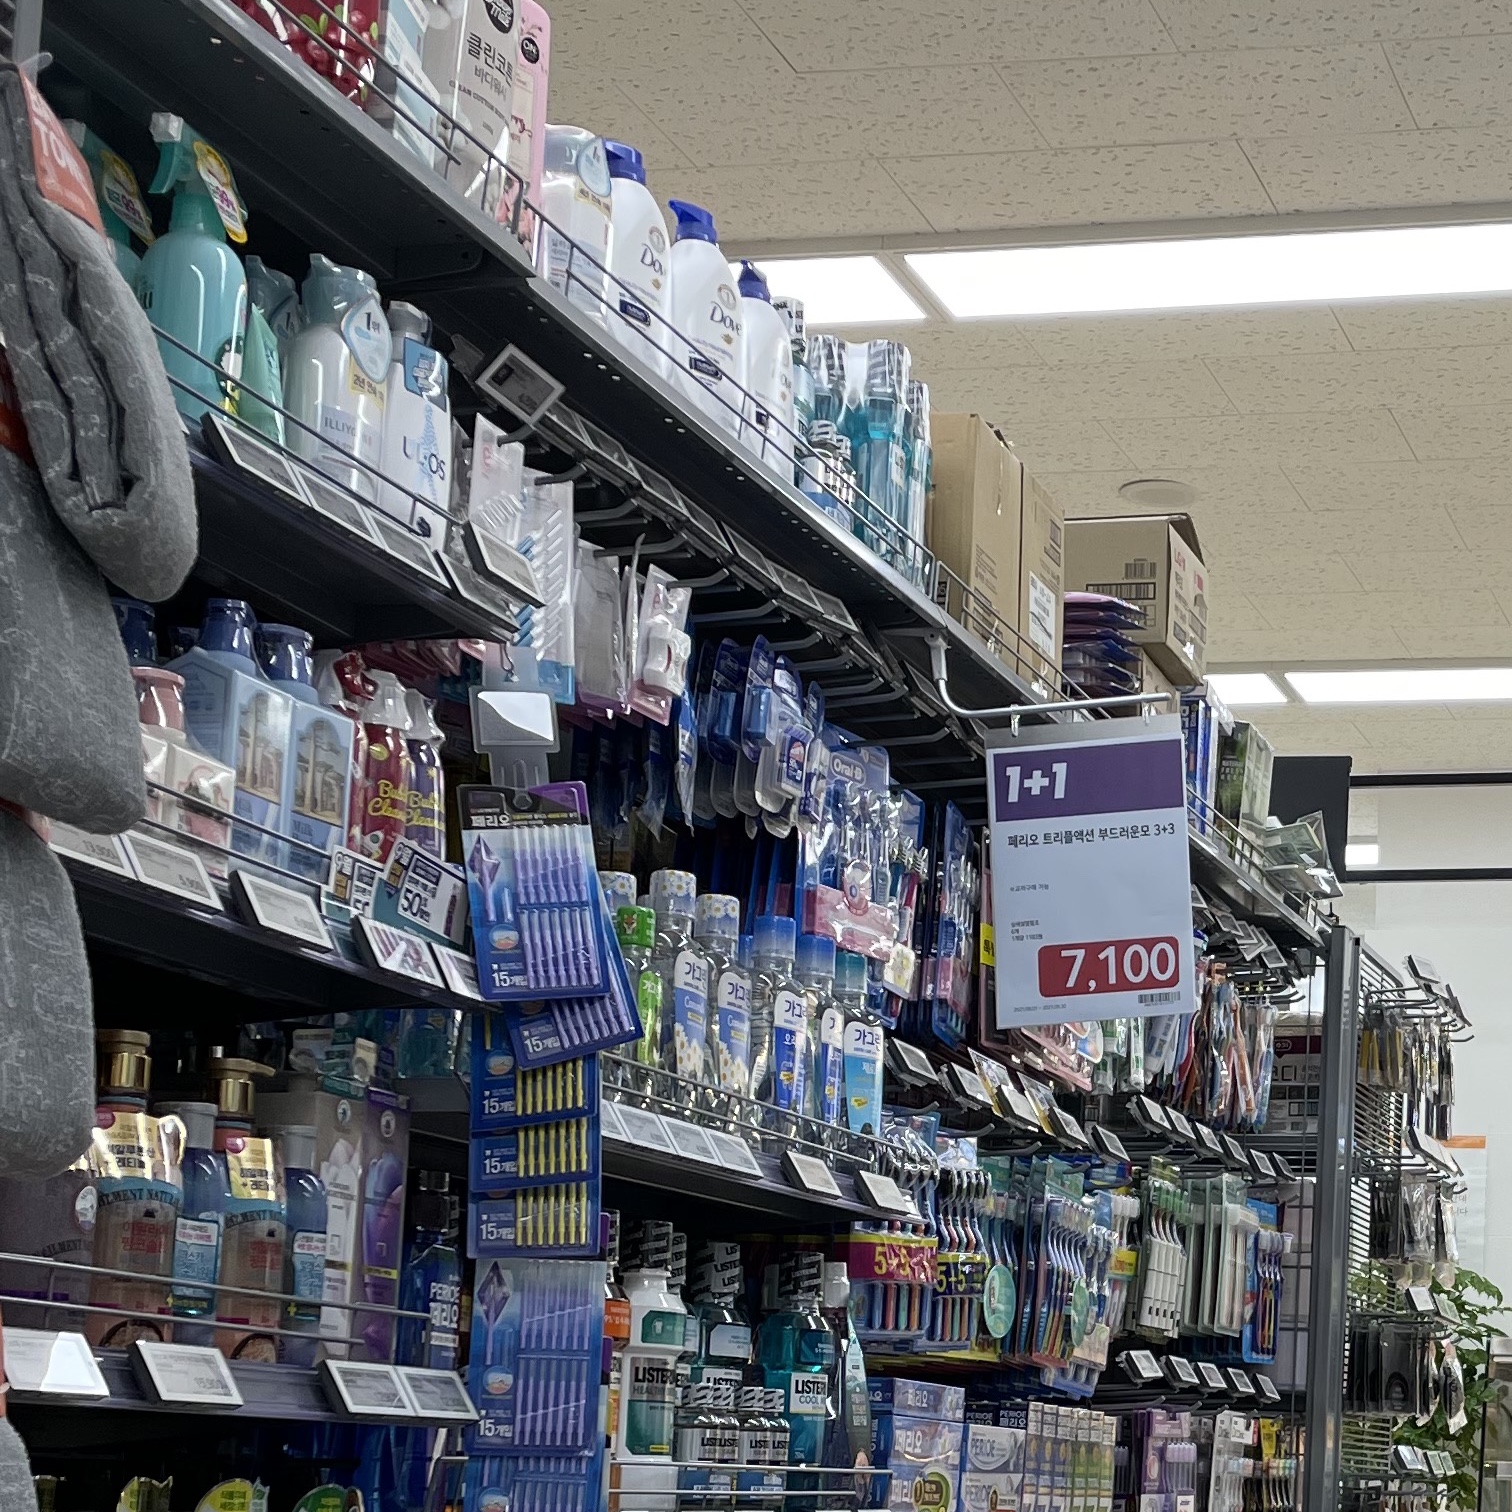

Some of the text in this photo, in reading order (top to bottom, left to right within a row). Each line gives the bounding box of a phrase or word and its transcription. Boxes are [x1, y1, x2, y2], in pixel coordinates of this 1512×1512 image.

[710, 301, 742, 337] Dove
[833, 758, 864, 781] Oral-B
[1005, 761, 1068, 803] 1+1
[471, 813, 511, 828] 페리오
[1007, 822, 1175, 848] 페리오 트리플액션 부드러운모 3+3
[393, 841, 414, 863] 9월
[401, 889, 422, 918] 50
[1060, 941, 1177, 993] 7,100
[491, 970, 529, 988] 15개입
[523, 1035, 560, 1053] 15개입
[481, 1097, 516, 1115] 15개입
[483, 1156, 518, 1175] 15개입
[479, 1222, 516, 1241] 15개입
[430, 1302, 460, 1330] 페리오
[478, 1418, 513, 1438] 15개입
